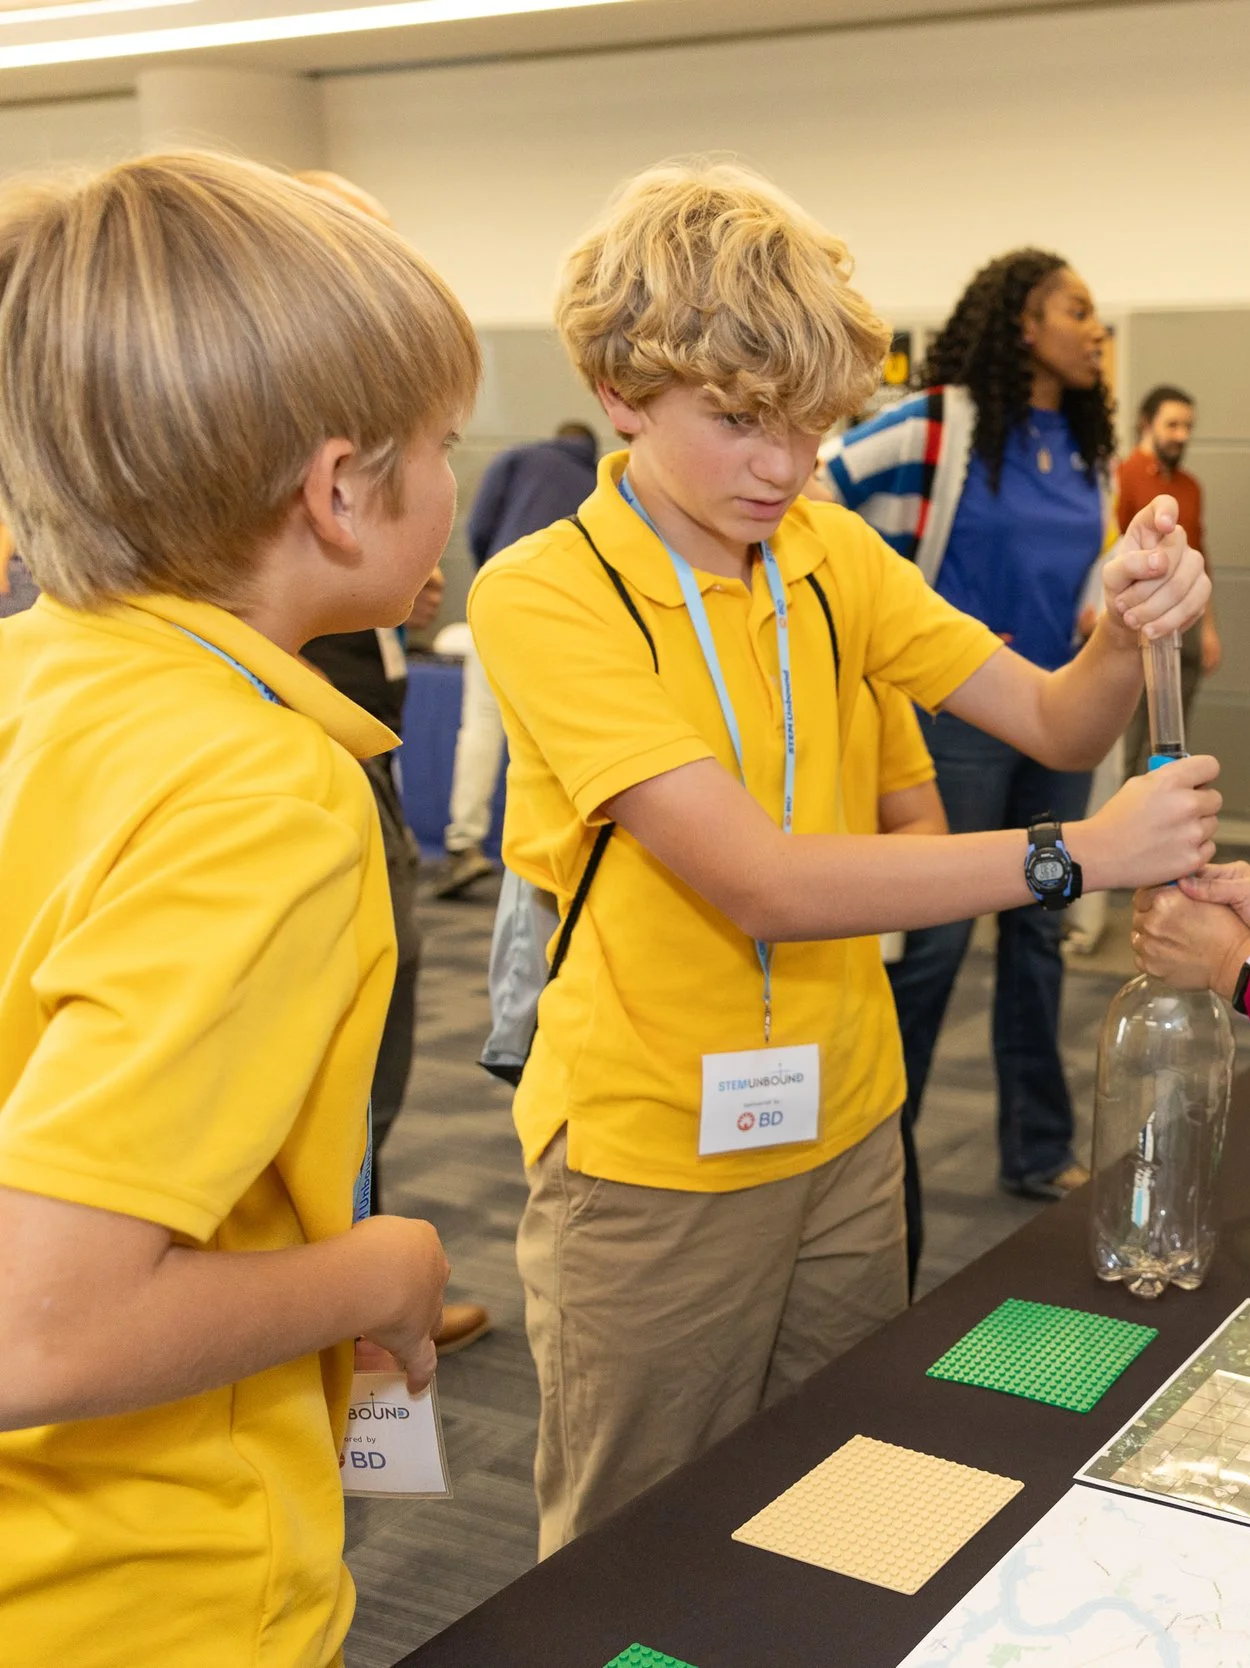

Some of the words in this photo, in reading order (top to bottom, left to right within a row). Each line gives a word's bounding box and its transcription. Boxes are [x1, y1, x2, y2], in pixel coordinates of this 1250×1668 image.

[759, 1110, 784, 1128] BD
[348, 1407, 410, 1420] BOUND
[366, 1436, 376, 1444] by
[351, 1451, 386, 1469] BD
